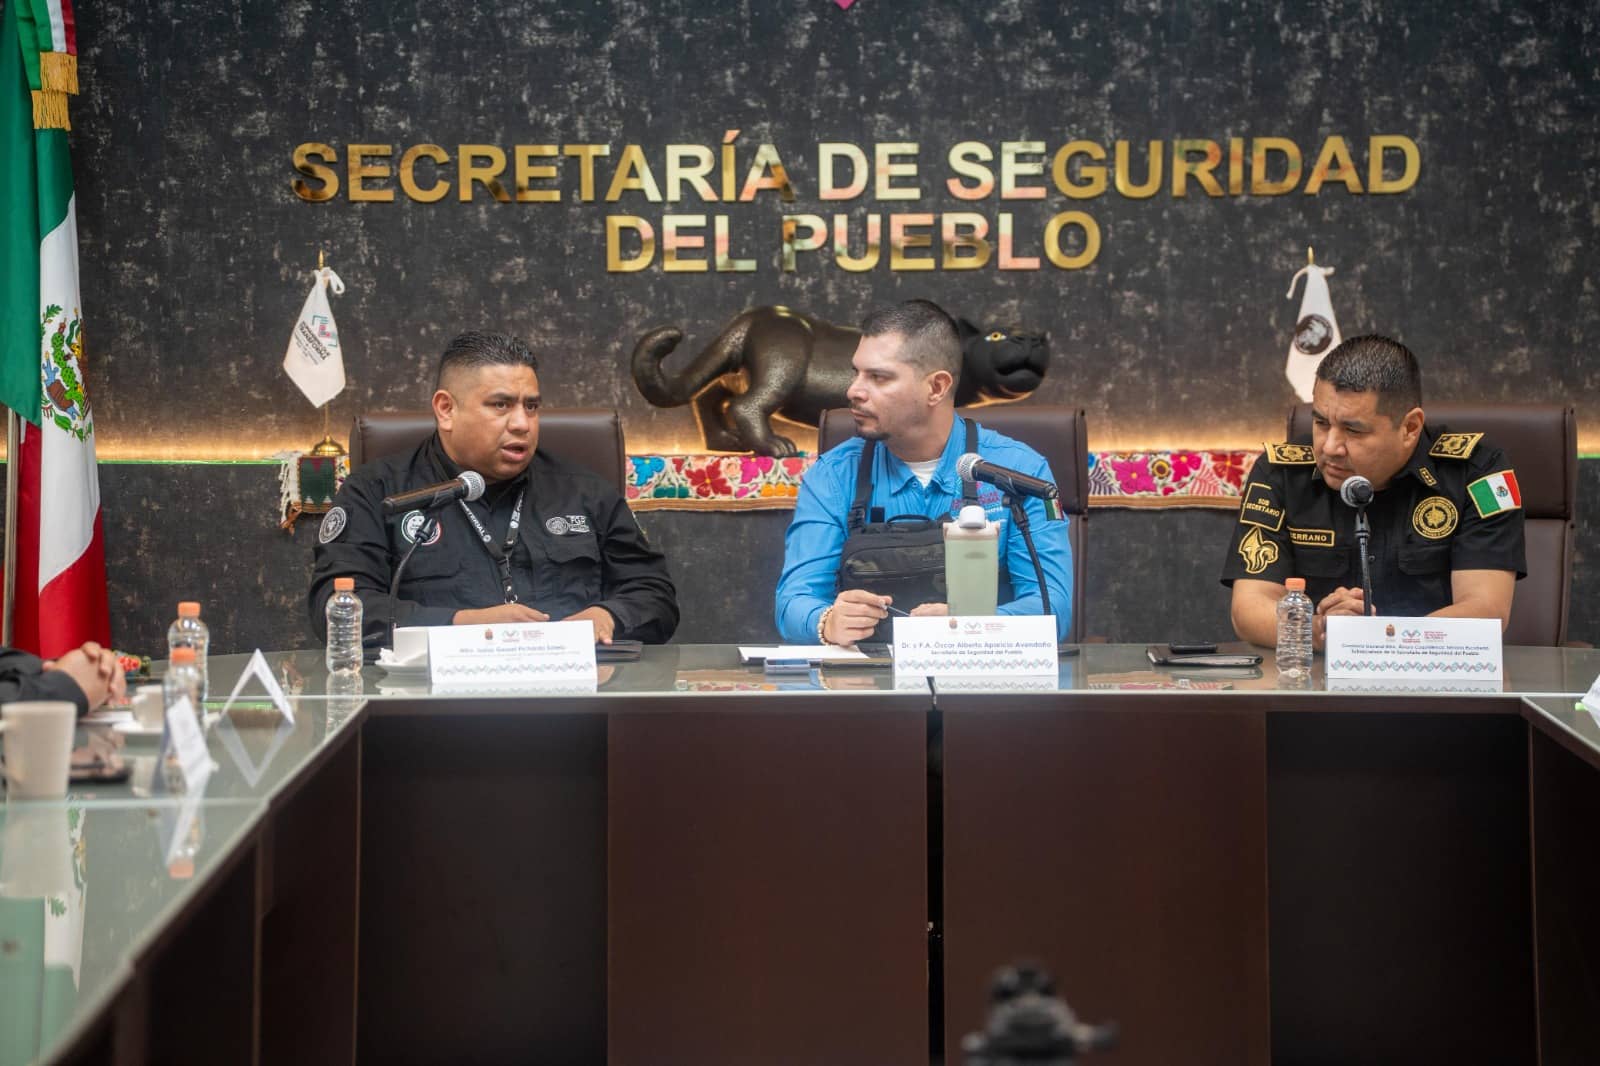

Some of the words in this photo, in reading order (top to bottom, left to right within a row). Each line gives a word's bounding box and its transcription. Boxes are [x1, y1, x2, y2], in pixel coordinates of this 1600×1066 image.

[291, 129, 796, 203] SECRETARÍA
[817, 141, 922, 200] DE
[946, 134, 1421, 199] SEGURIDAD
[605, 214, 757, 273] DEL
[781, 210, 1102, 273] PUEBLO
